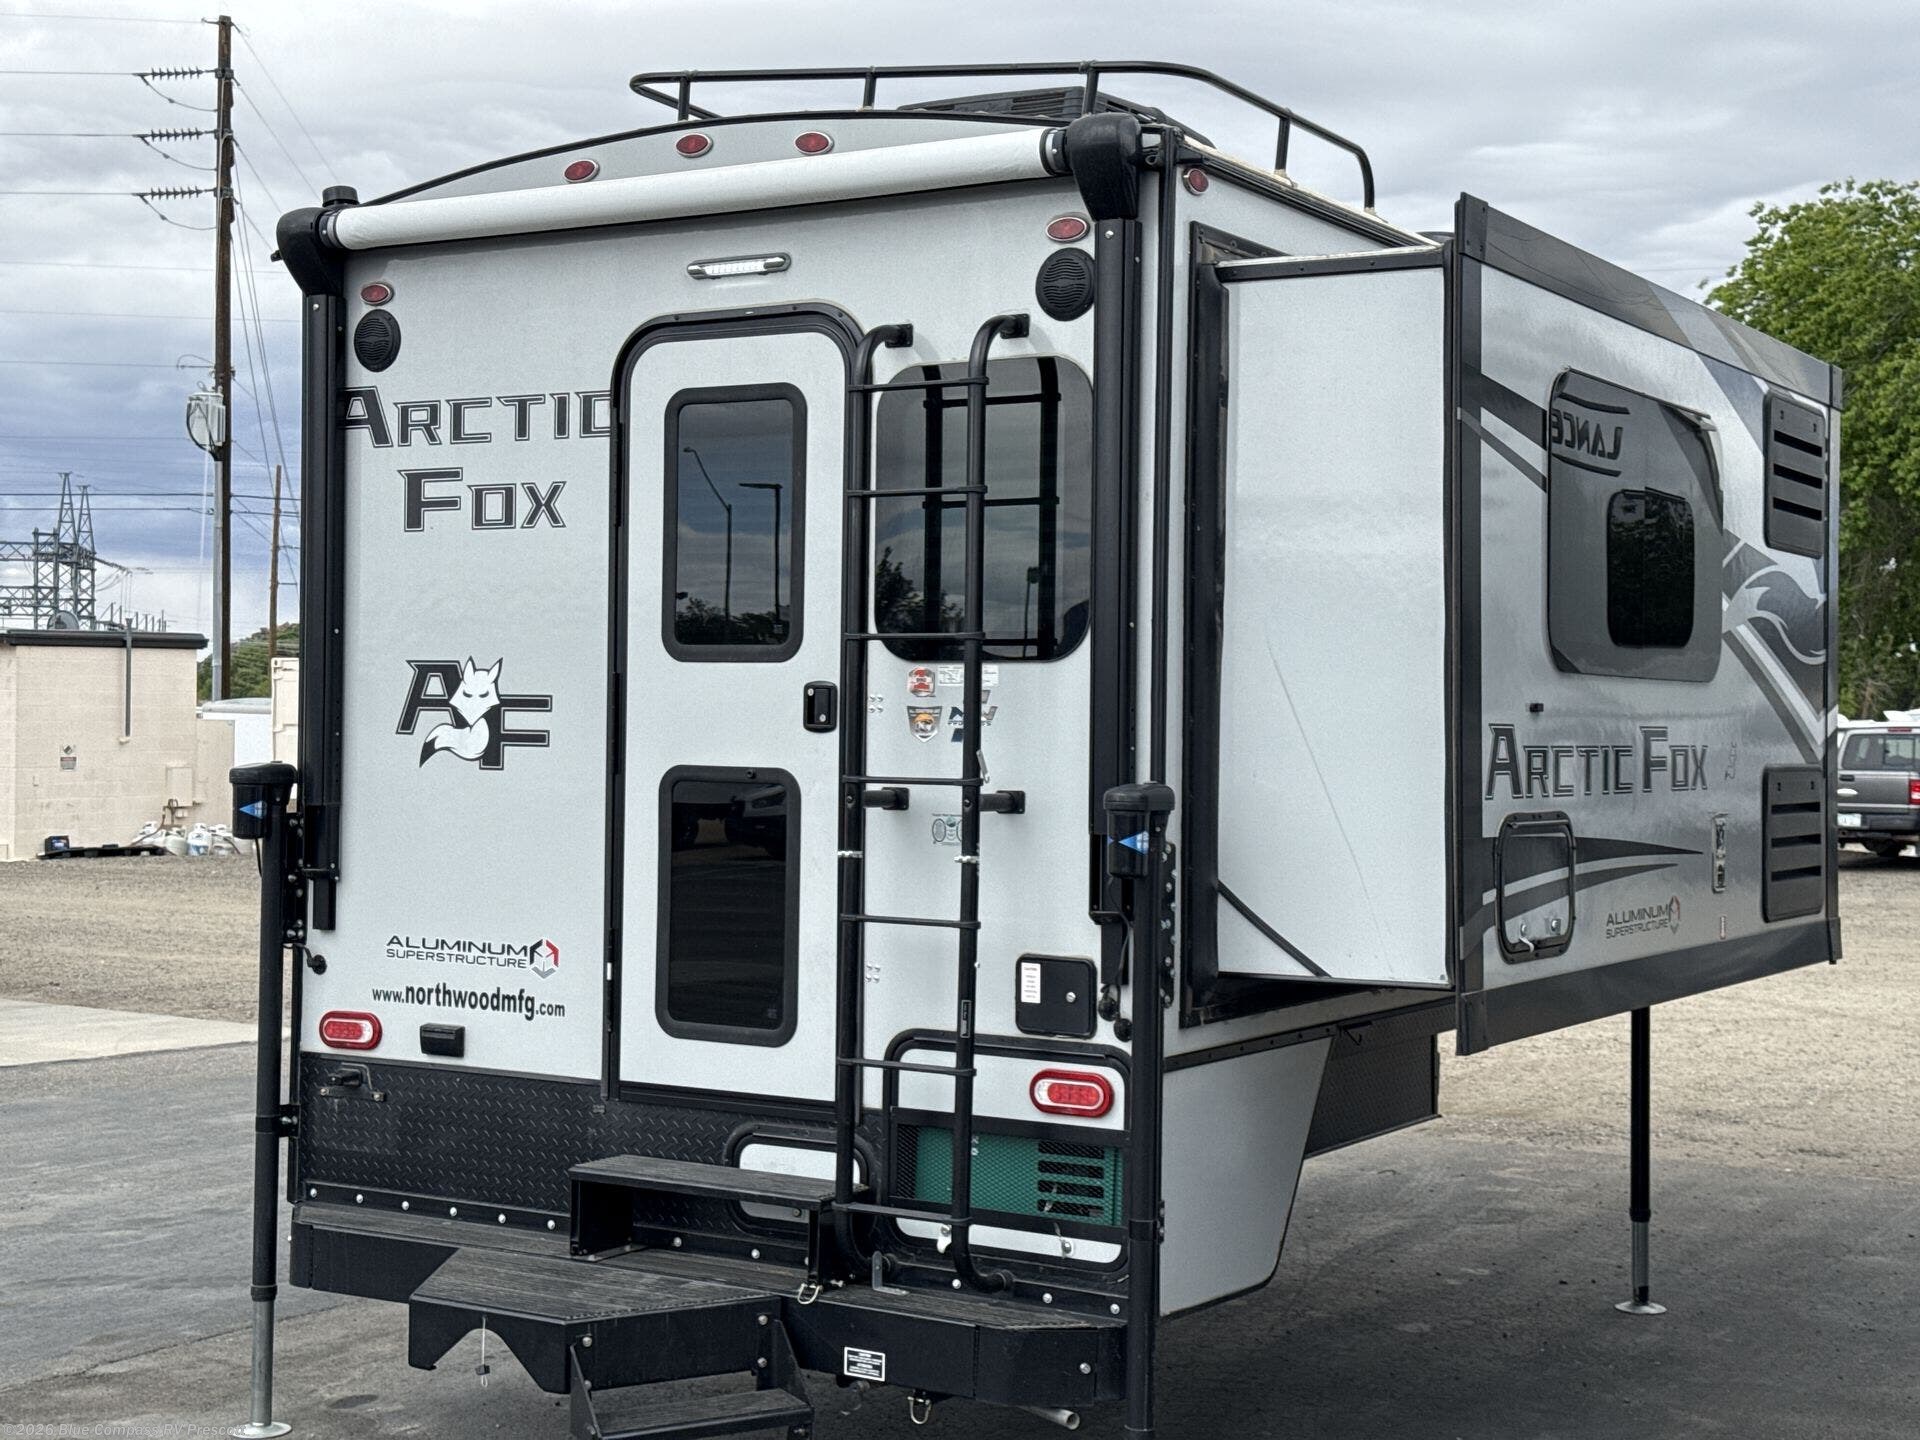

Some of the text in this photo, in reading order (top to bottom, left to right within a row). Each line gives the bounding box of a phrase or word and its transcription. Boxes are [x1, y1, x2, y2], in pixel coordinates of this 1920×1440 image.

[1606, 904, 1669, 927] ALUMINUM
[386, 935, 529, 957] ALUMINUM
[386, 948, 528, 969] SUPERSTRUCTURE
[372, 982, 566, 1021] www.northwoodmfg.com
